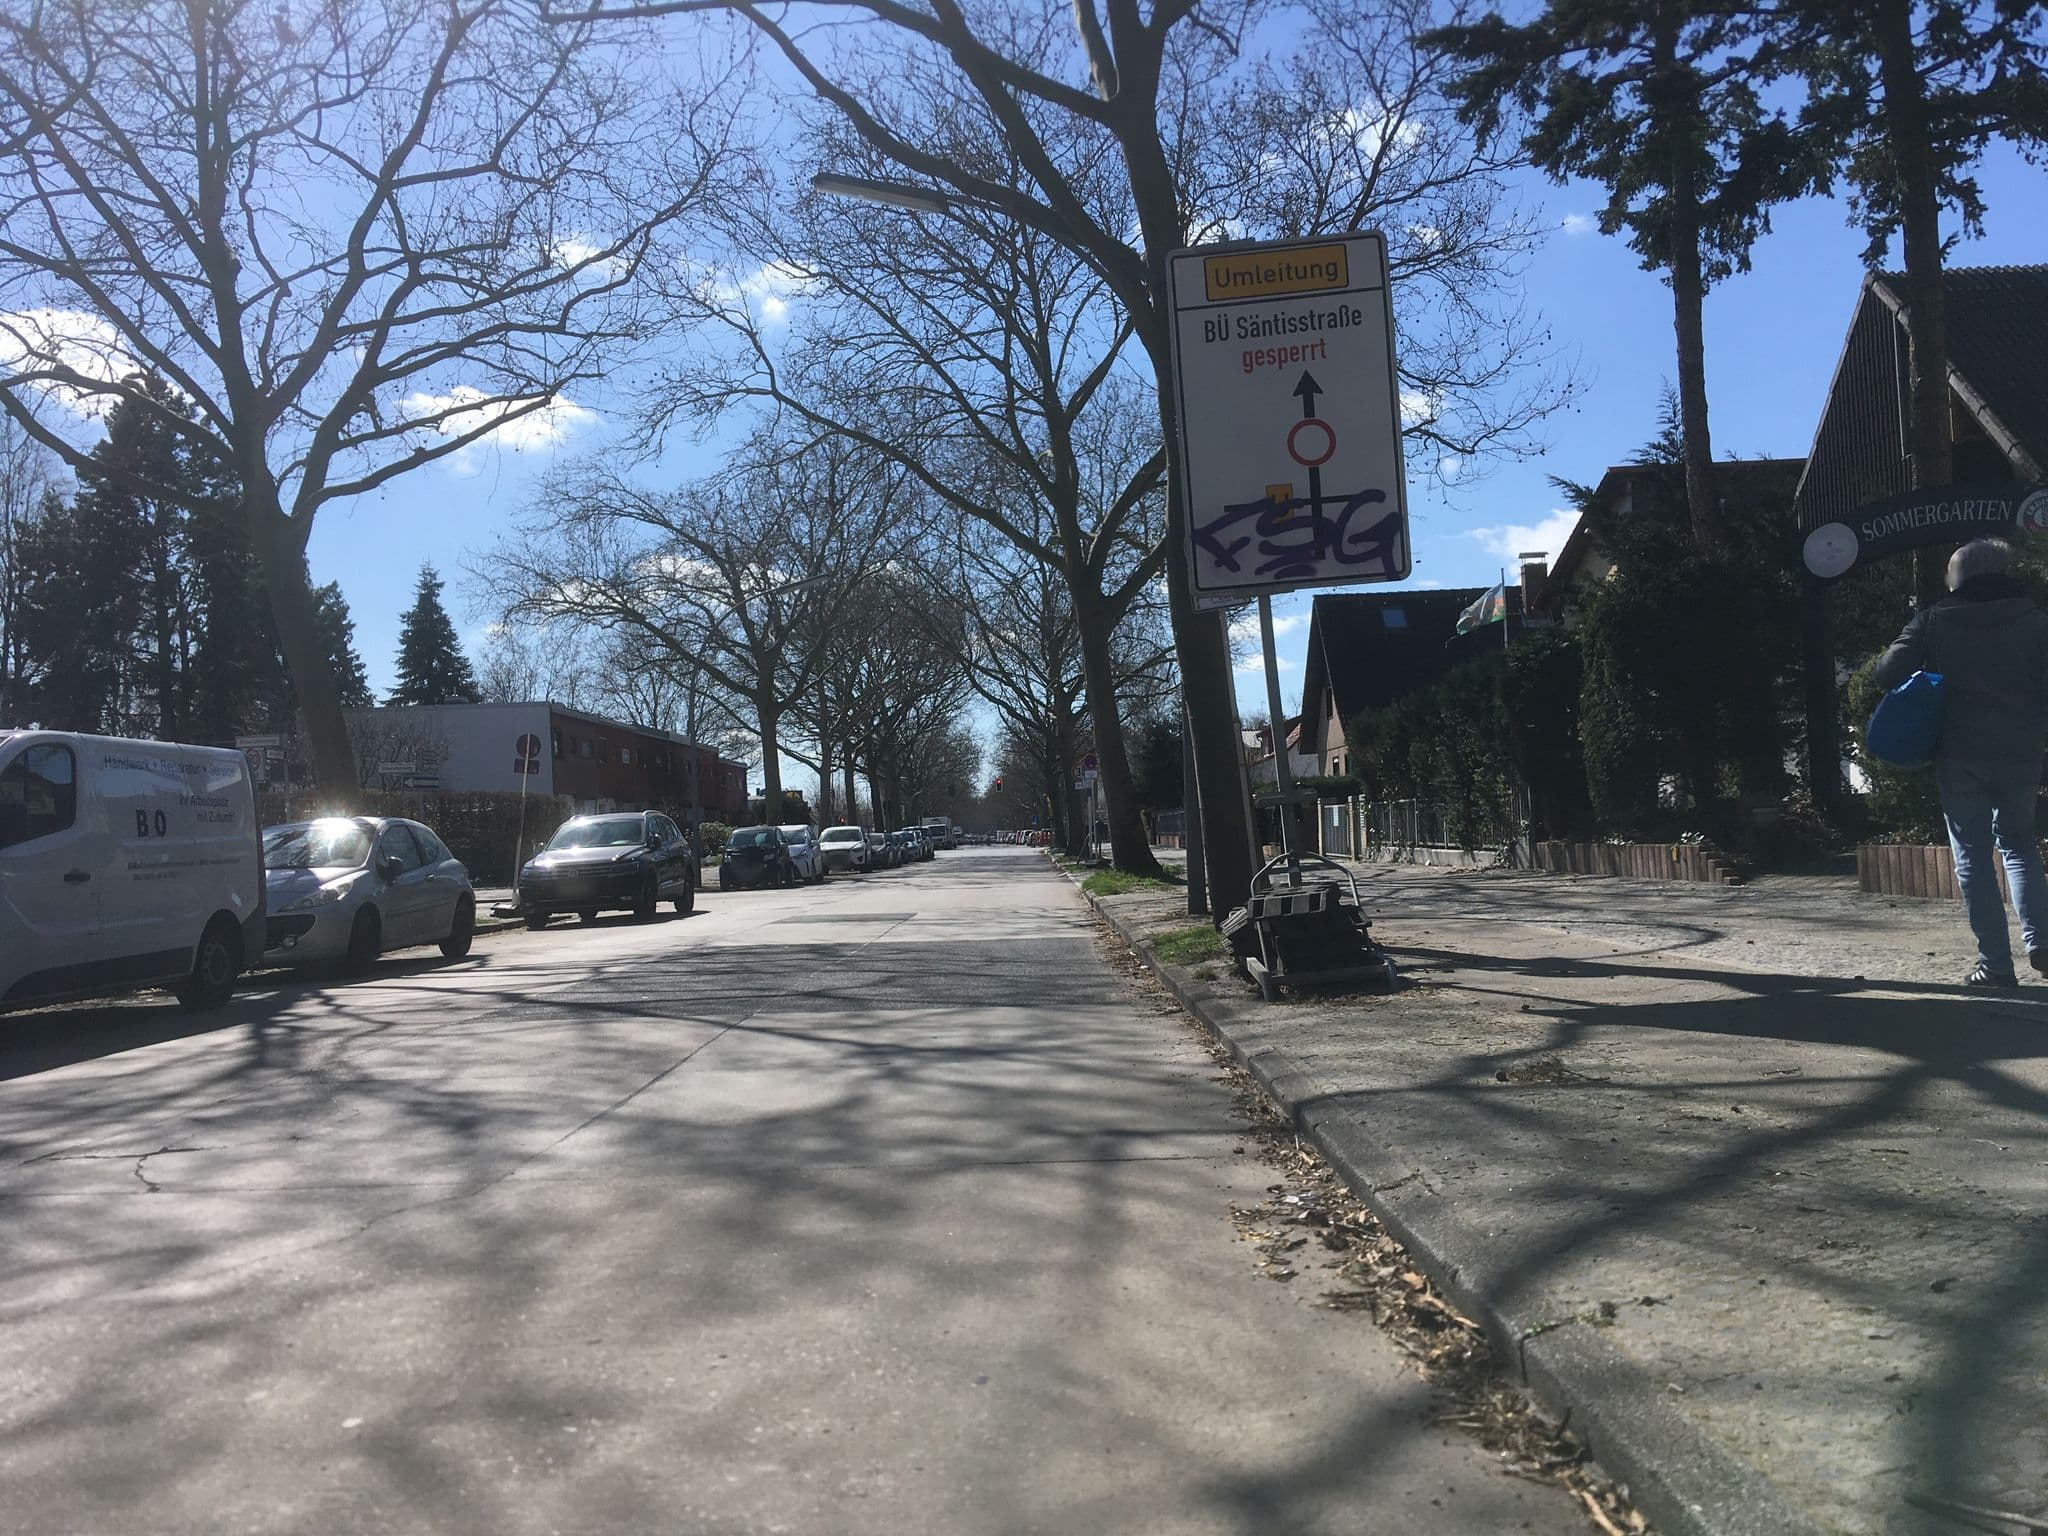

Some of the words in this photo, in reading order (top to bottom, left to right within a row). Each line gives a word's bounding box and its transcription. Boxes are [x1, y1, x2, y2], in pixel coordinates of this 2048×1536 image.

[1215, 261, 1338, 288] Umleitung
[1204, 313, 1230, 343] BÜ
[1236, 304, 1362, 340] Säntisstraße
[1242, 338, 1327, 374] gesperrt
[1862, 500, 2013, 542] SOMMERGARTEN
